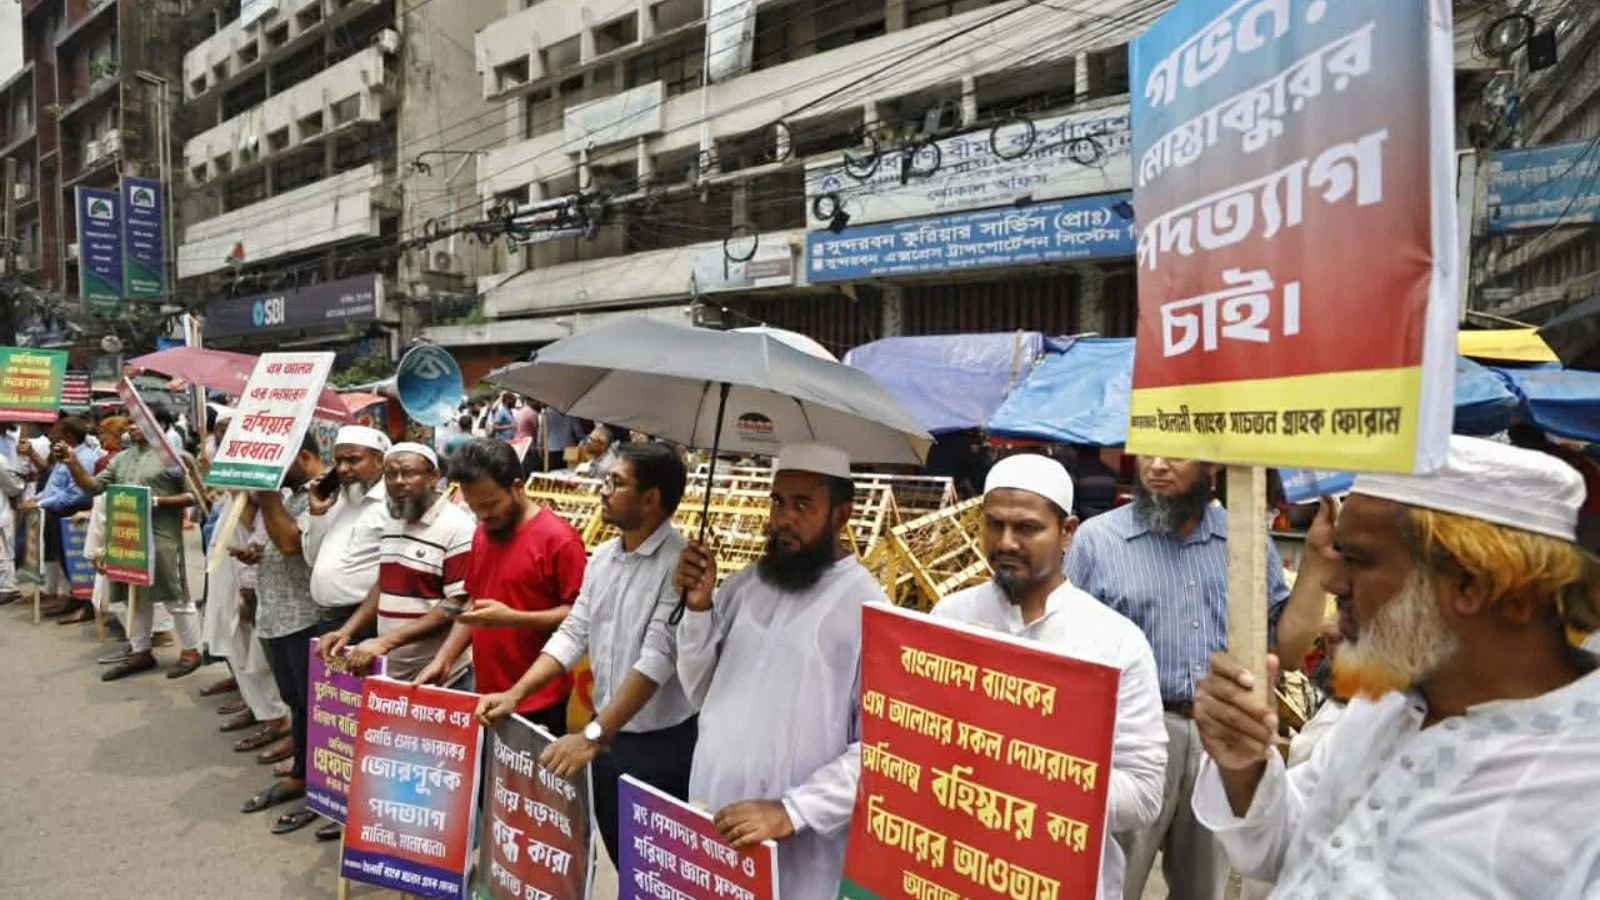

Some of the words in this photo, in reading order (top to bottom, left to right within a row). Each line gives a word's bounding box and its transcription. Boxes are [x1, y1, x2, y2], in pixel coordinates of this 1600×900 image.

[1136, 127, 1389, 271] পদত্যাগ
[979, 209, 1046, 235] সার্ভিস
[264, 296, 285, 326] SBI
[1159, 267, 1301, 358] চাই।
[1192, 412, 1227, 436] ব্যাংক
[1282, 409, 1327, 436] গ্রাহক
[1330, 406, 1402, 438] ফোরাম
[900, 646, 978, 691] বাংলাদেশ
[981, 668, 1057, 716] ব্যাংকের
[450, 711, 471, 729] এর
[863, 689, 885, 718] এস
[956, 721, 1004, 761] সকল
[361, 755, 463, 796] জোরপূর্বক
[368, 797, 447, 832] পদত্যাগ
[492, 814, 525, 863] বন্ধ
[650, 811, 698, 850] পেশাদার
[742, 856, 756, 877] ও
[680, 857, 711, 891] জ্ঞান
